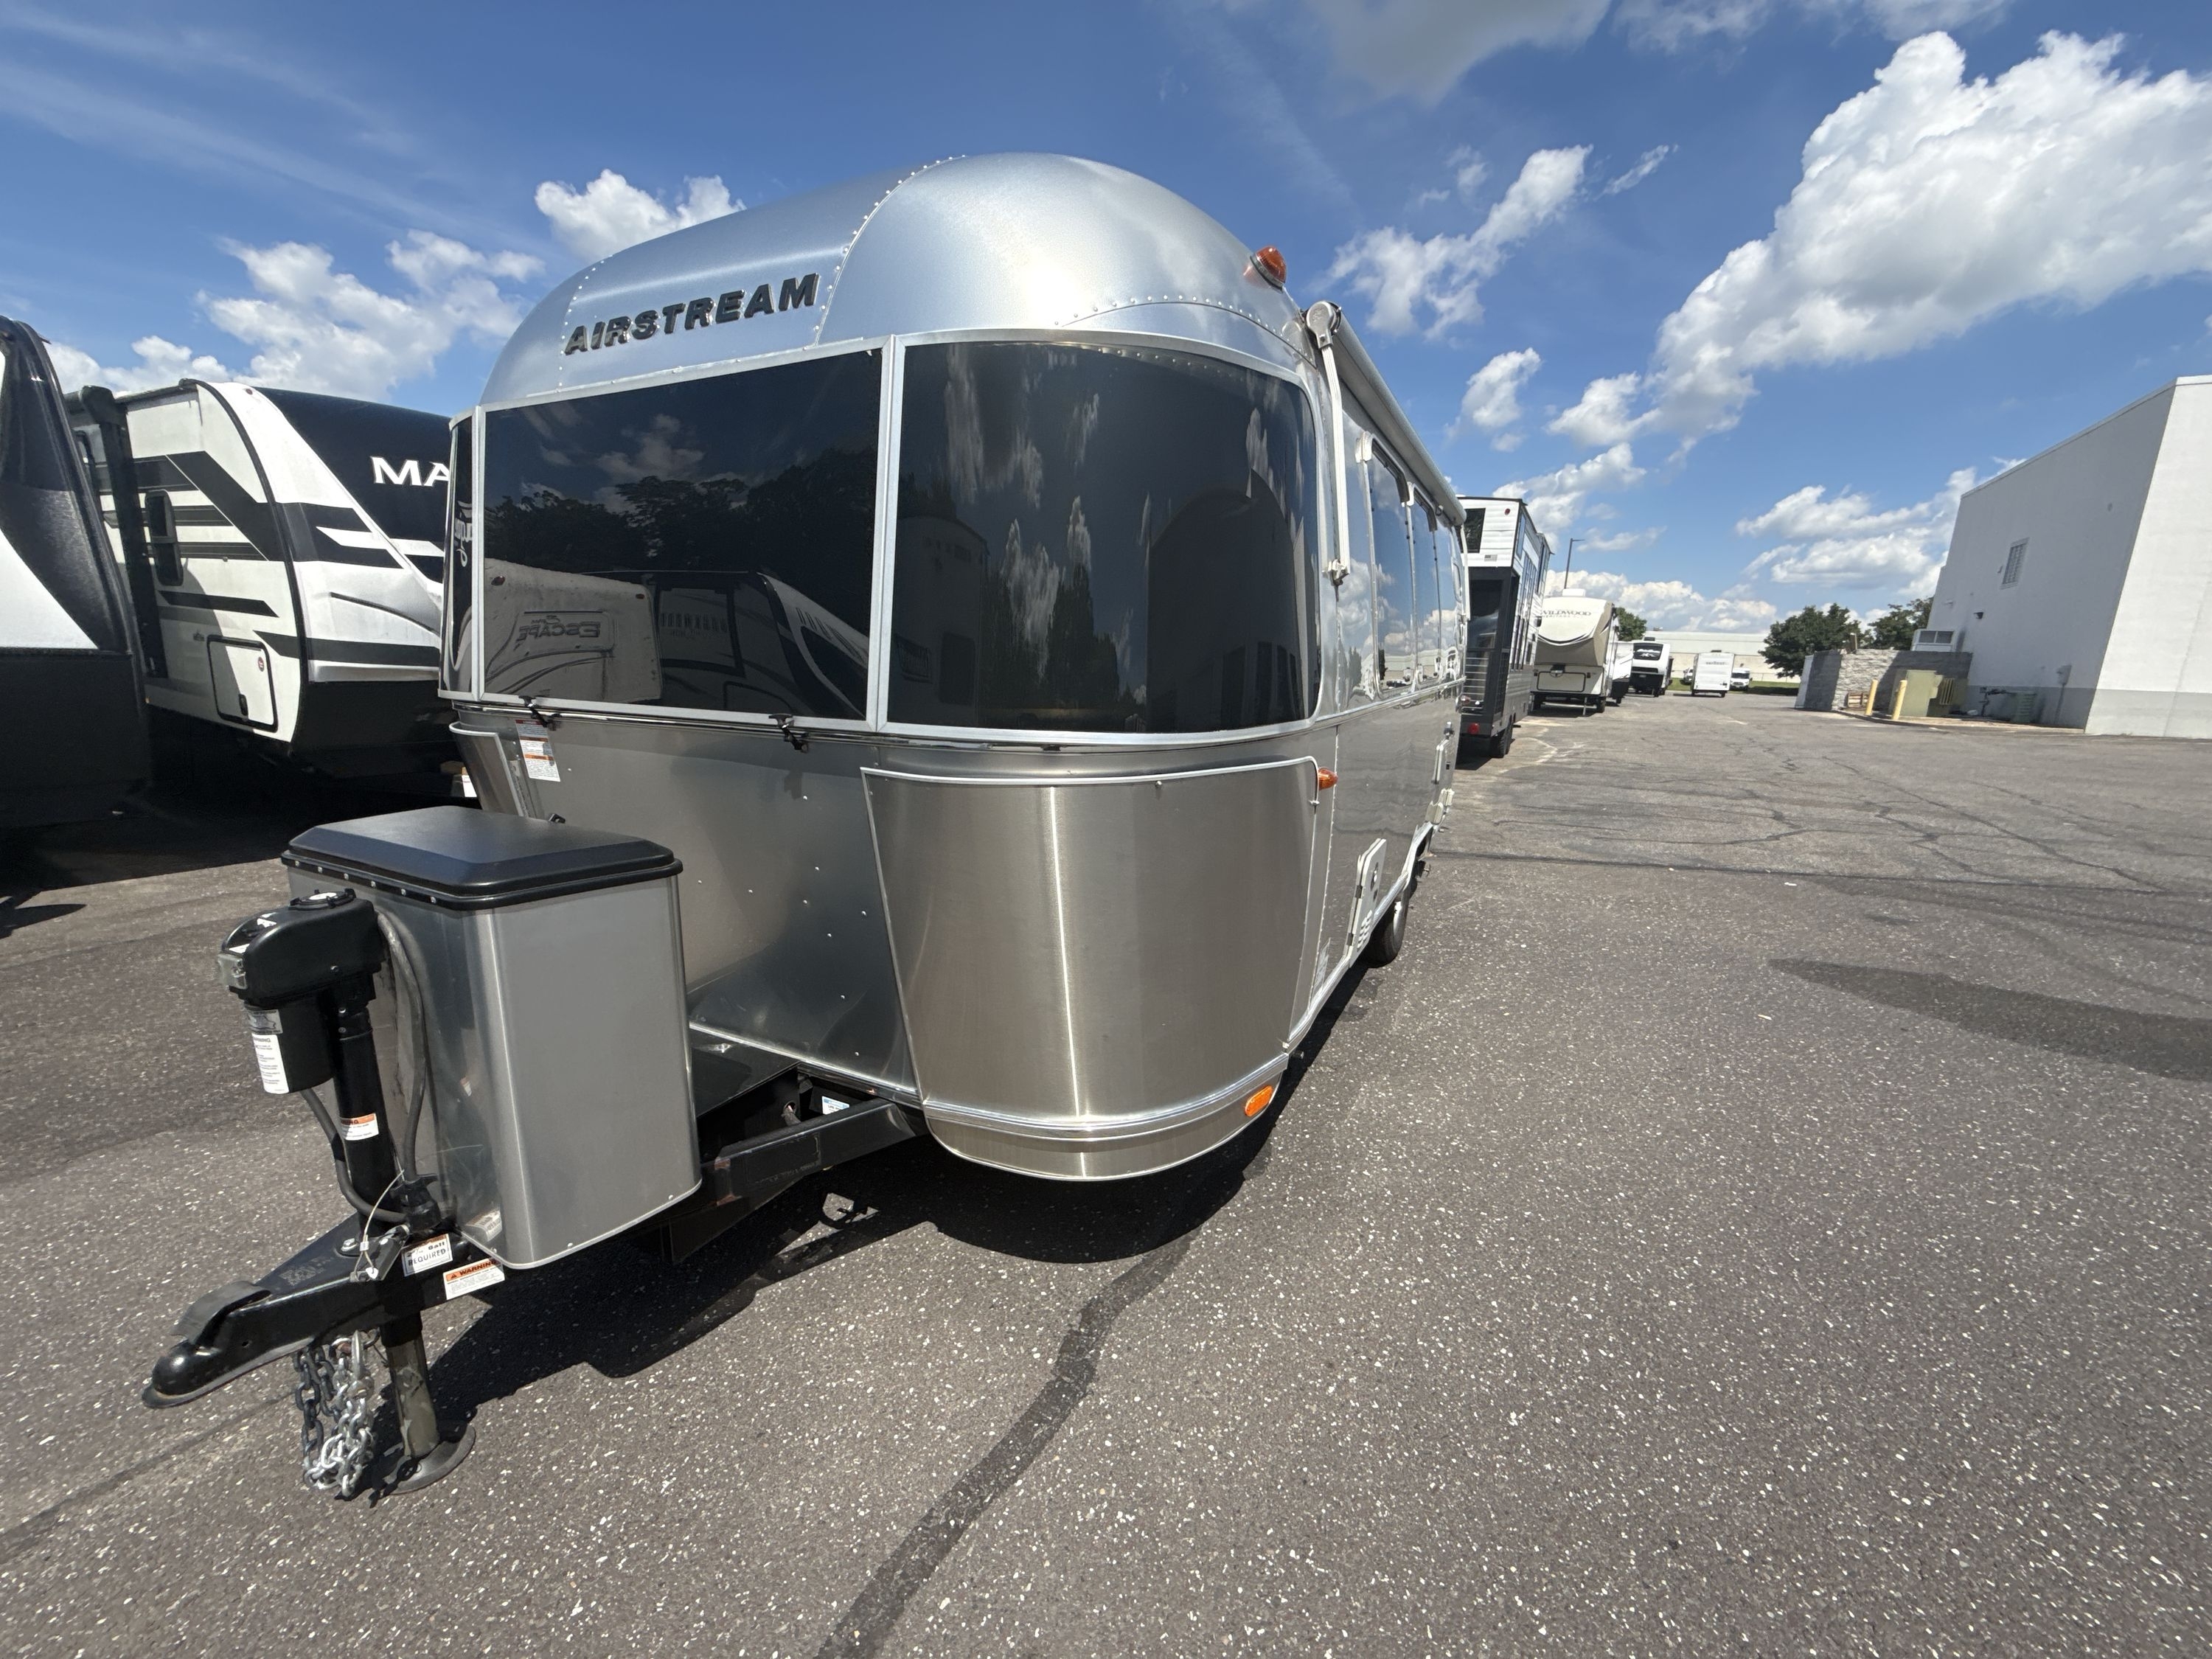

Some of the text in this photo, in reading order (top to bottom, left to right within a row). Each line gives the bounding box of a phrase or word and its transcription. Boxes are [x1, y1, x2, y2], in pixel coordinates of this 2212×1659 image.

[565, 273, 820, 355] AIRSTREAM
[408, 1248, 446, 1266] REQUIRED
[459, 1260, 497, 1275] WARNING
